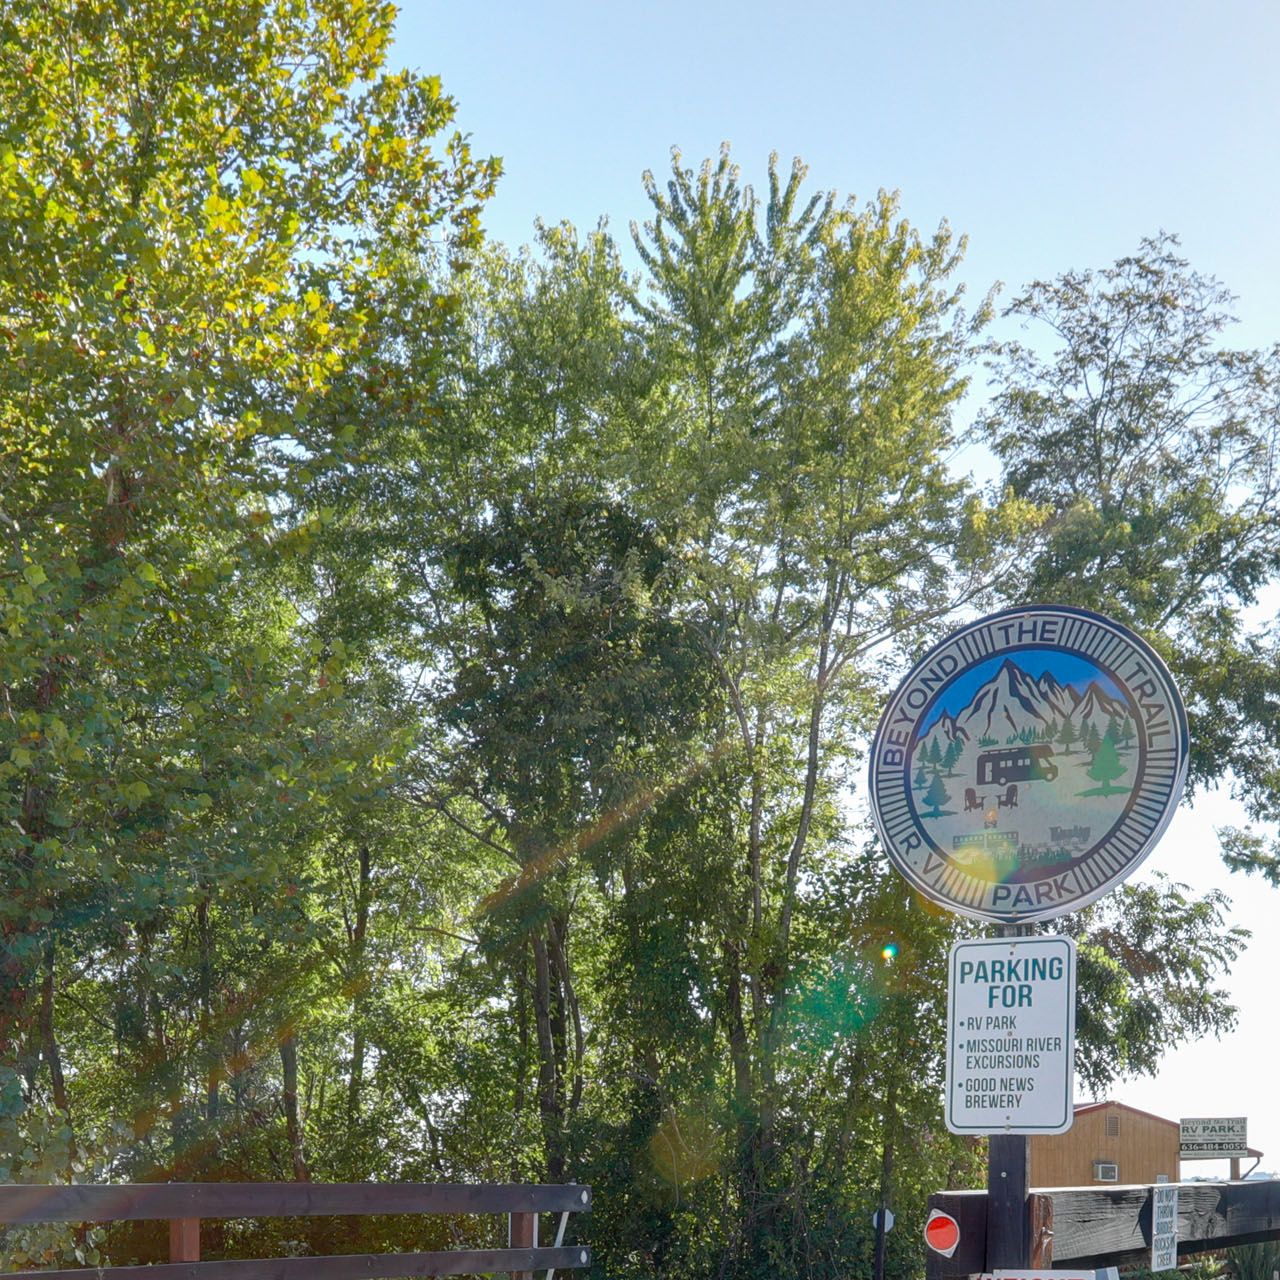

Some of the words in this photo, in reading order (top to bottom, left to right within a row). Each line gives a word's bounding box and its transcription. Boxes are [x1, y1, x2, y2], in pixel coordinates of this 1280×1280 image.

[883, 653, 959, 767] BEYOND
[997, 619, 1059, 645] THE
[1124, 660, 1171, 748] TRAIL
[991, 872, 1077, 907] PARK
[959, 954, 1064, 984] PARKING
[988, 984, 1033, 1008] FOR
[967, 1017, 983, 1031] RV
[986, 1015, 1017, 1030] PARK
[966, 1038, 1023, 1053] MISSOURI
[1026, 1037, 1062, 1052] RIVER
[966, 1054, 1040, 1070] EXCURSIONS
[965, 1078, 997, 1092] GOOD
[1000, 1077, 1034, 1092] NEWS
[965, 1094, 1023, 1109] BREWERY
[1181, 1126, 1198, 1134] RV
